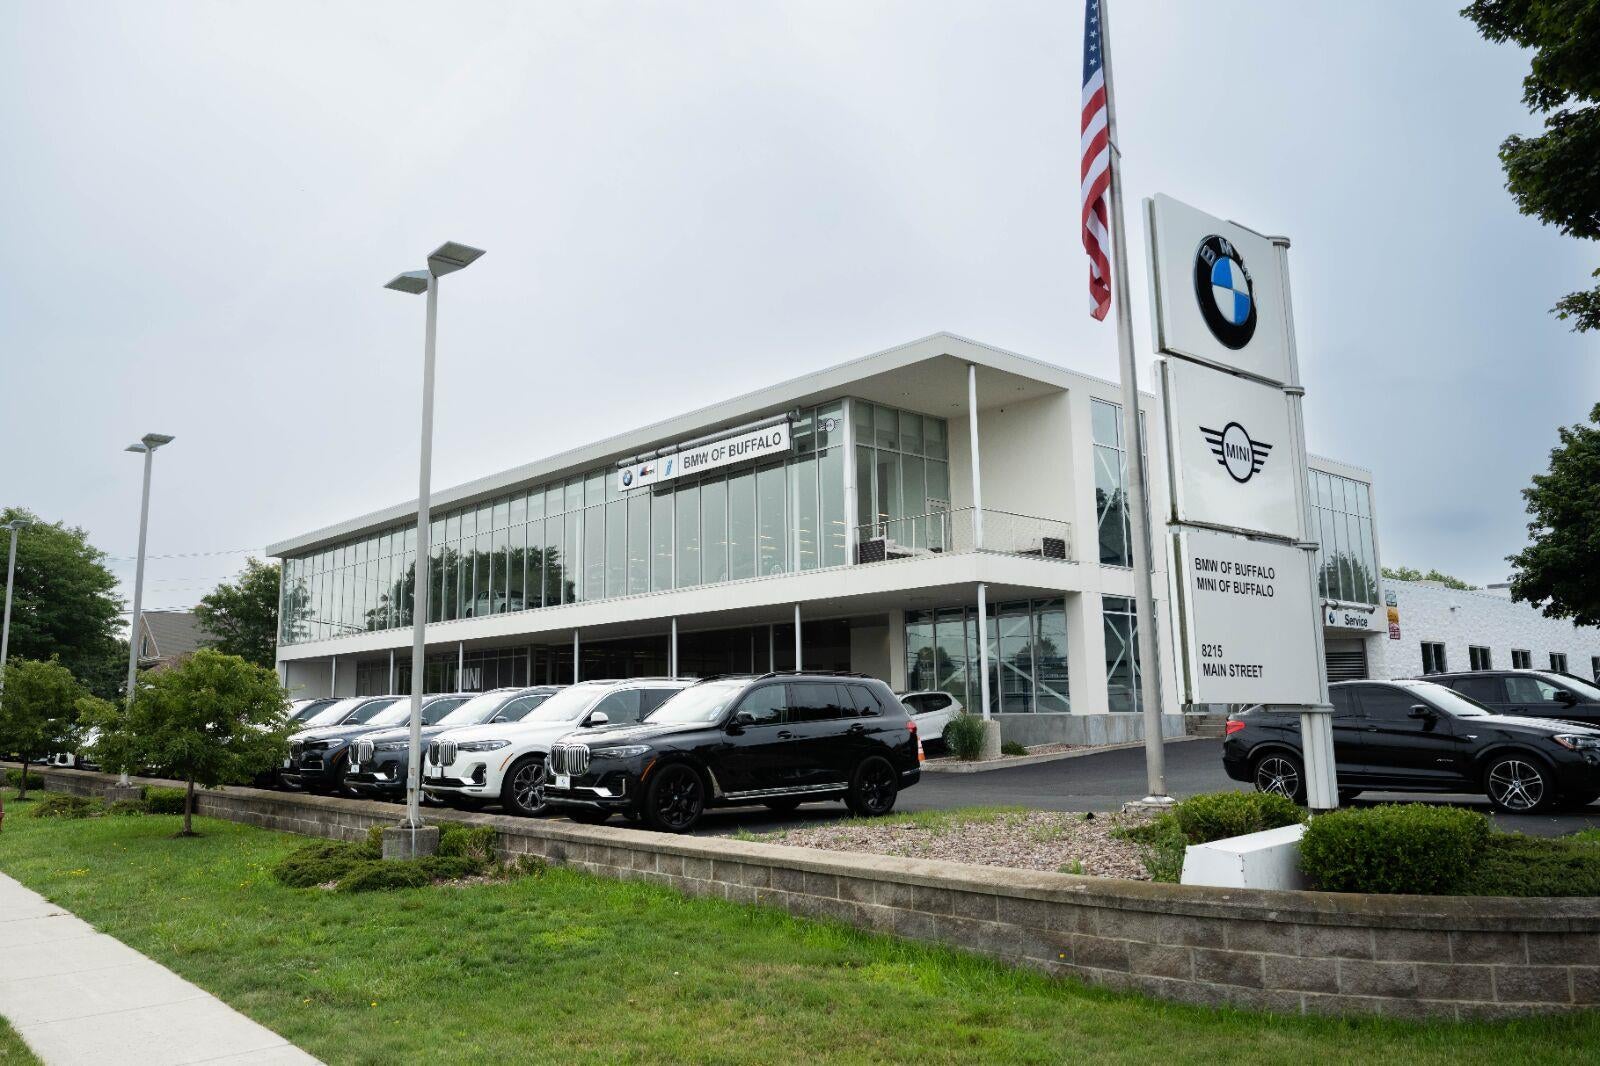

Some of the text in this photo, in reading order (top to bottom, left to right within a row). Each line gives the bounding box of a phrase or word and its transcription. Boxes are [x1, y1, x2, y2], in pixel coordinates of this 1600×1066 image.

[683, 432, 782, 469] BMW OF BUFFALO
[1225, 442, 1250, 462] MINI
[1195, 557, 1275, 580] BMW OF BUFFALO
[1197, 577, 1274, 598] MINI OF BUFFALO
[1344, 613, 1368, 628] Service
[1201, 643, 1223, 658] 8215
[1202, 663, 1263, 678] MAIN STREET
